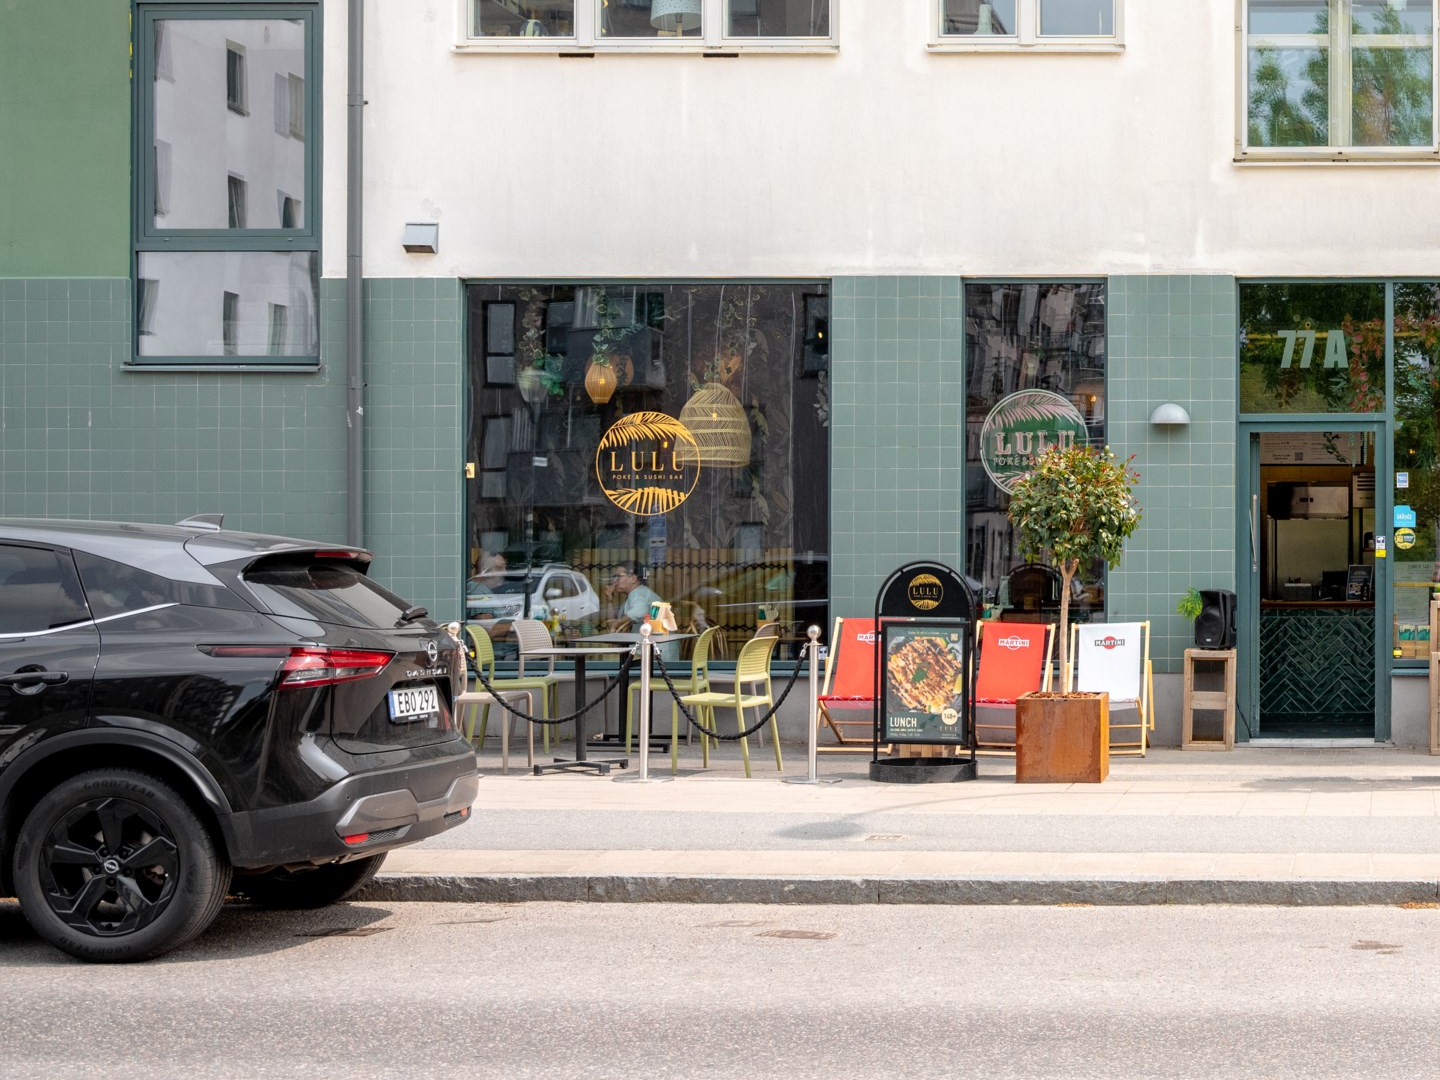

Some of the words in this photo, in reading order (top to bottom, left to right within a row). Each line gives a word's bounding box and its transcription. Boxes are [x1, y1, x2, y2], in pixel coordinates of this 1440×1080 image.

[994, 429, 1076, 455] LULU
[610, 451, 685, 472] LULU
[913, 587, 939, 596] LULU
[999, 638, 1029, 647] MARTINI
[1095, 639, 1124, 647] MARTINI
[418, 689, 436, 712] 292
[889, 716, 917, 728] LUNCH
